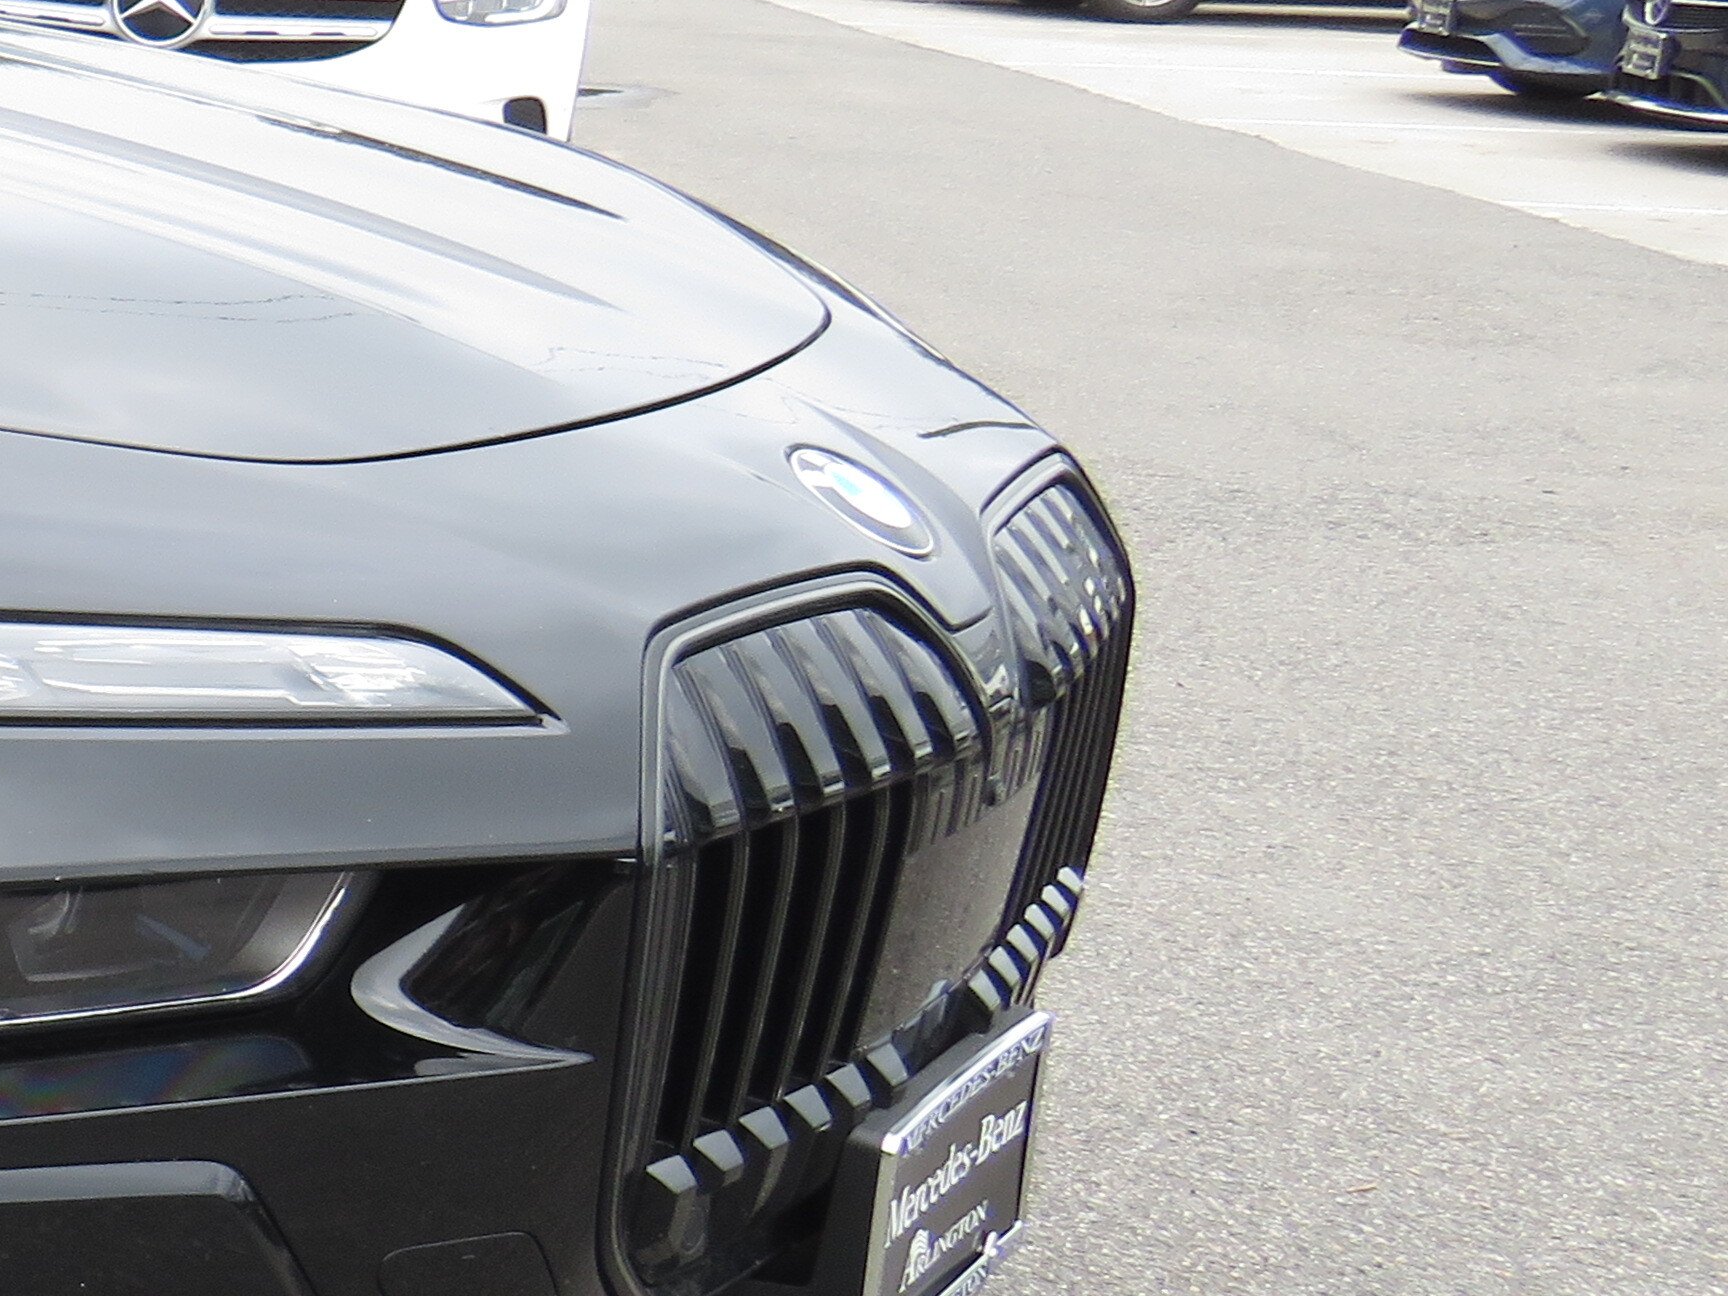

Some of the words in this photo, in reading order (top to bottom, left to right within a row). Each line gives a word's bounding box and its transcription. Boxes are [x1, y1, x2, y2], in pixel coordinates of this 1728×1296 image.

[900, 1026, 1045, 1157] MERCEDES-BENZ
[884, 1101, 1027, 1249] Mercedes-Benz
[898, 1199, 988, 1293] ARLINGTON
